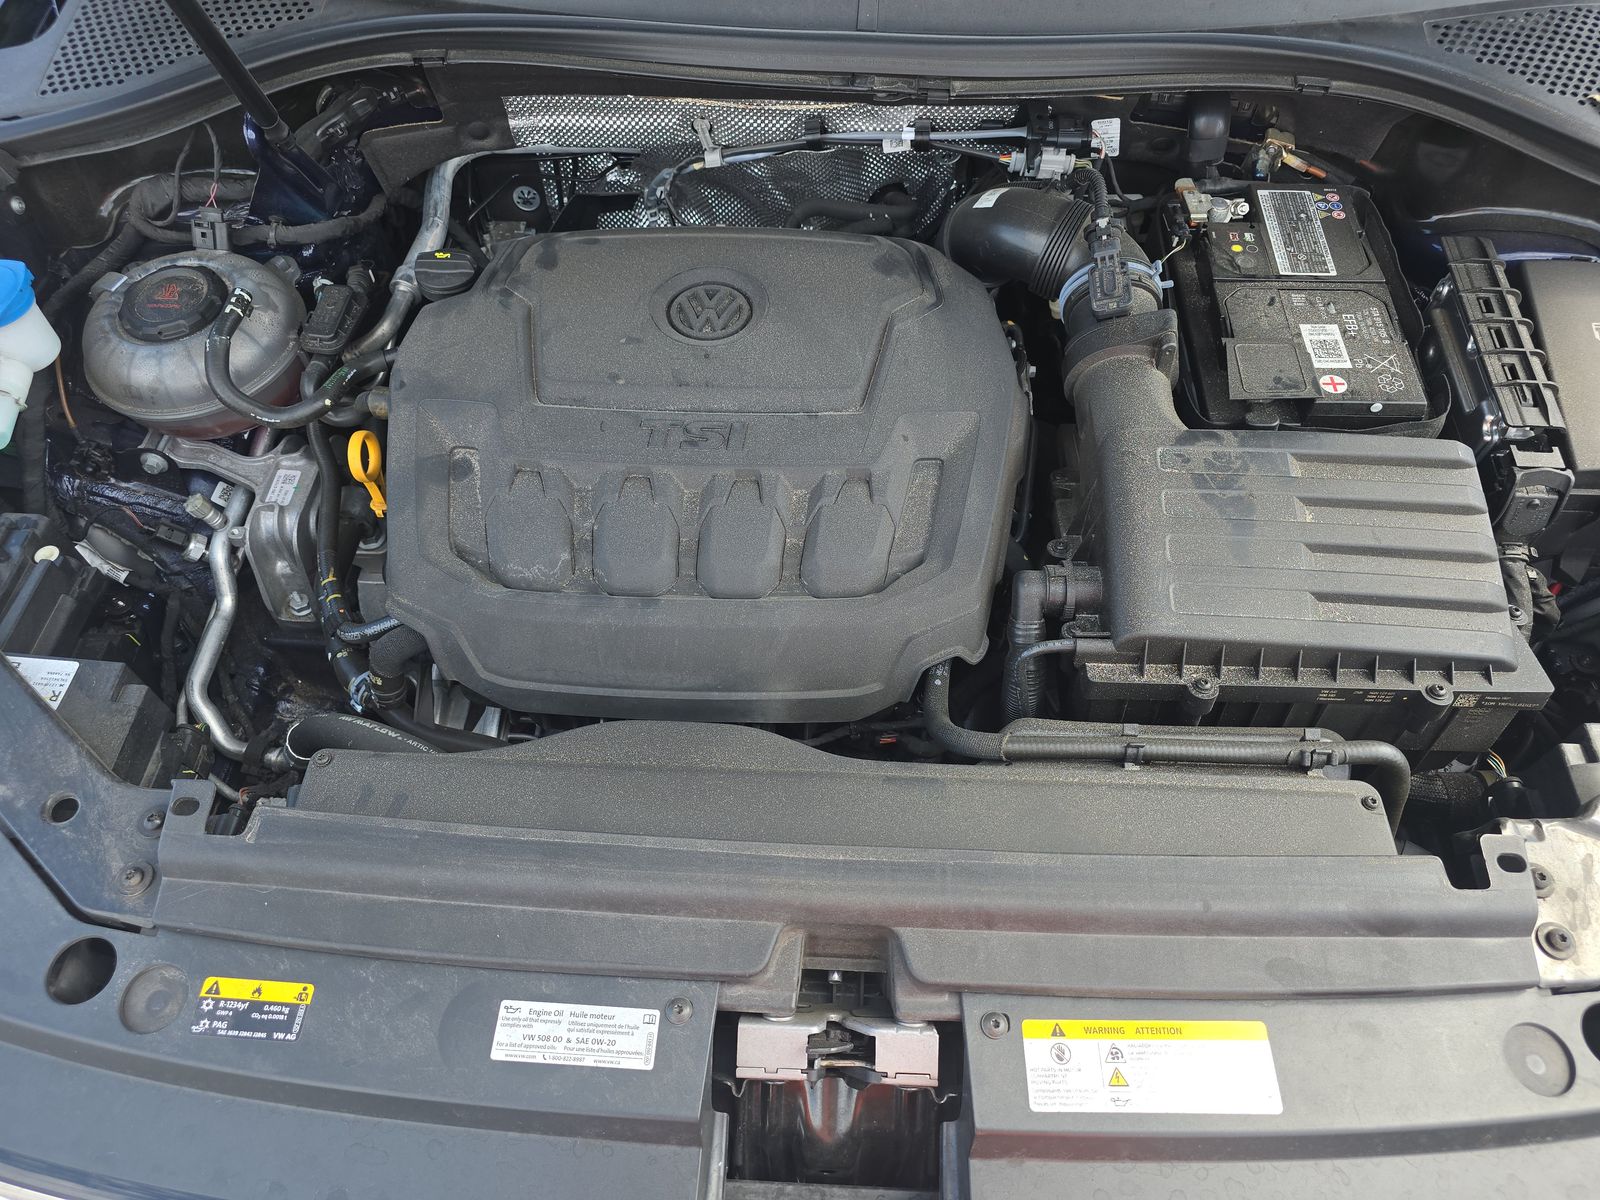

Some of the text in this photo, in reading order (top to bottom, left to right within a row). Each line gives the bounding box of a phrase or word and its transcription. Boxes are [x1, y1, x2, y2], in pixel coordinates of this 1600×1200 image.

[668, 283, 751, 340] VW
[1342, 314, 1358, 336] EFB+
[1354, 358, 1364, 368] Pb
[641, 419, 749, 451] TSI
[50, 690, 62, 702] R
[219, 1000, 250, 1010] R-1234yf
[282, 1006, 290, 1014] kg
[529, 1008, 552, 1017] Engine
[1083, 1026, 1183, 1035] WARNING ATTENTION
[591, 1038, 616, 1046] 0W-20
